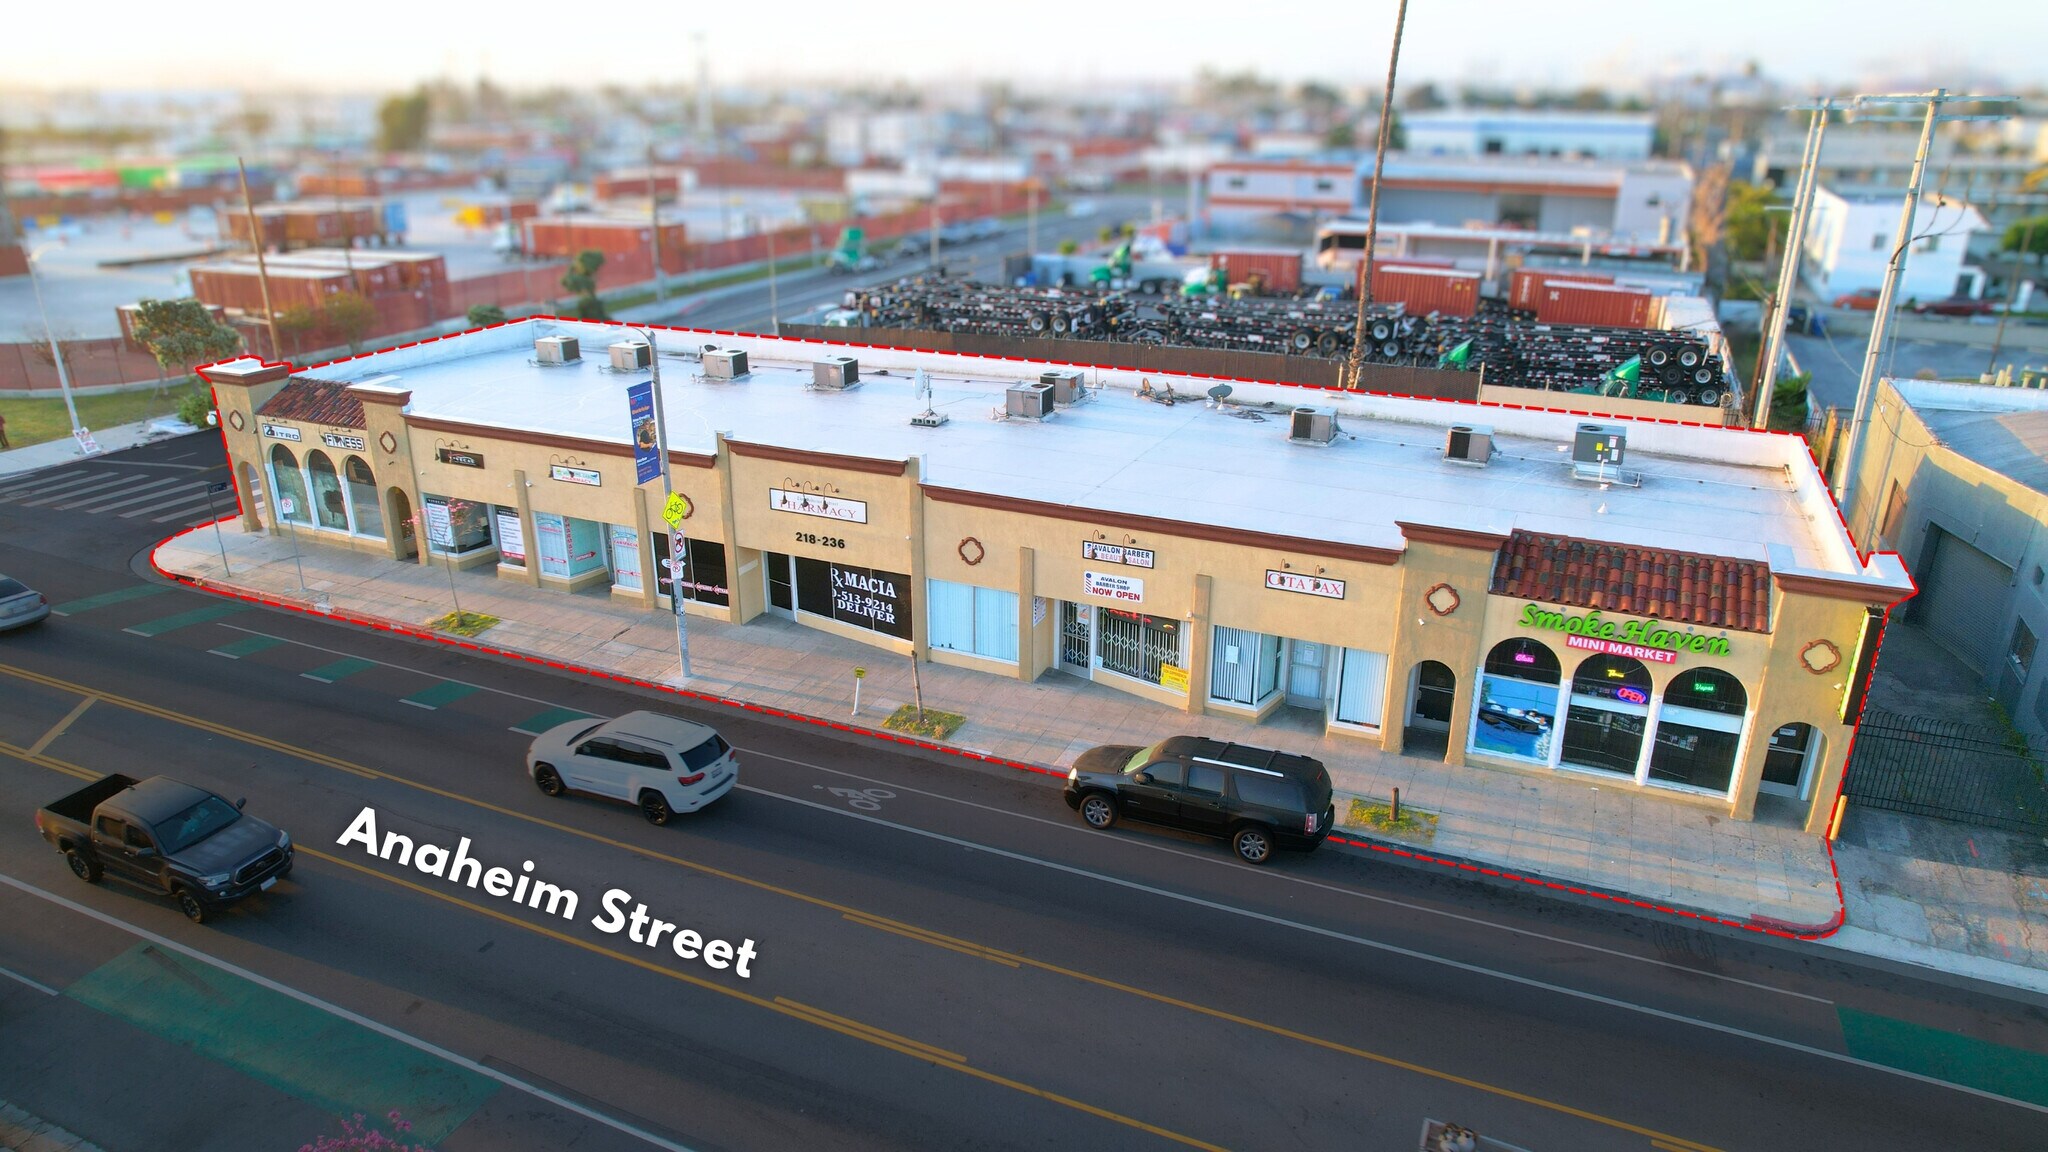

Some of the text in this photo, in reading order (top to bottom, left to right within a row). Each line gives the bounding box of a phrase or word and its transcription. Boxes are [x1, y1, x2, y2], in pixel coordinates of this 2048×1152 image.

[795, 531, 846, 549] 218-236
[1094, 544, 1150, 559] AVALON BARBER
[1100, 552, 1150, 566] BEAUT SALON
[844, 571, 897, 598] MACIA
[1100, 576, 1128, 585] AVALON
[1308, 579, 1341, 596] TAX
[1092, 587, 1140, 601] NOW OPEN
[837, 598, 896, 625] DELIVER
[1518, 602, 1731, 657] Smoke Haven
[1568, 636, 1675, 663] MINI MARKET
[1618, 687, 1646, 703] OPEN
